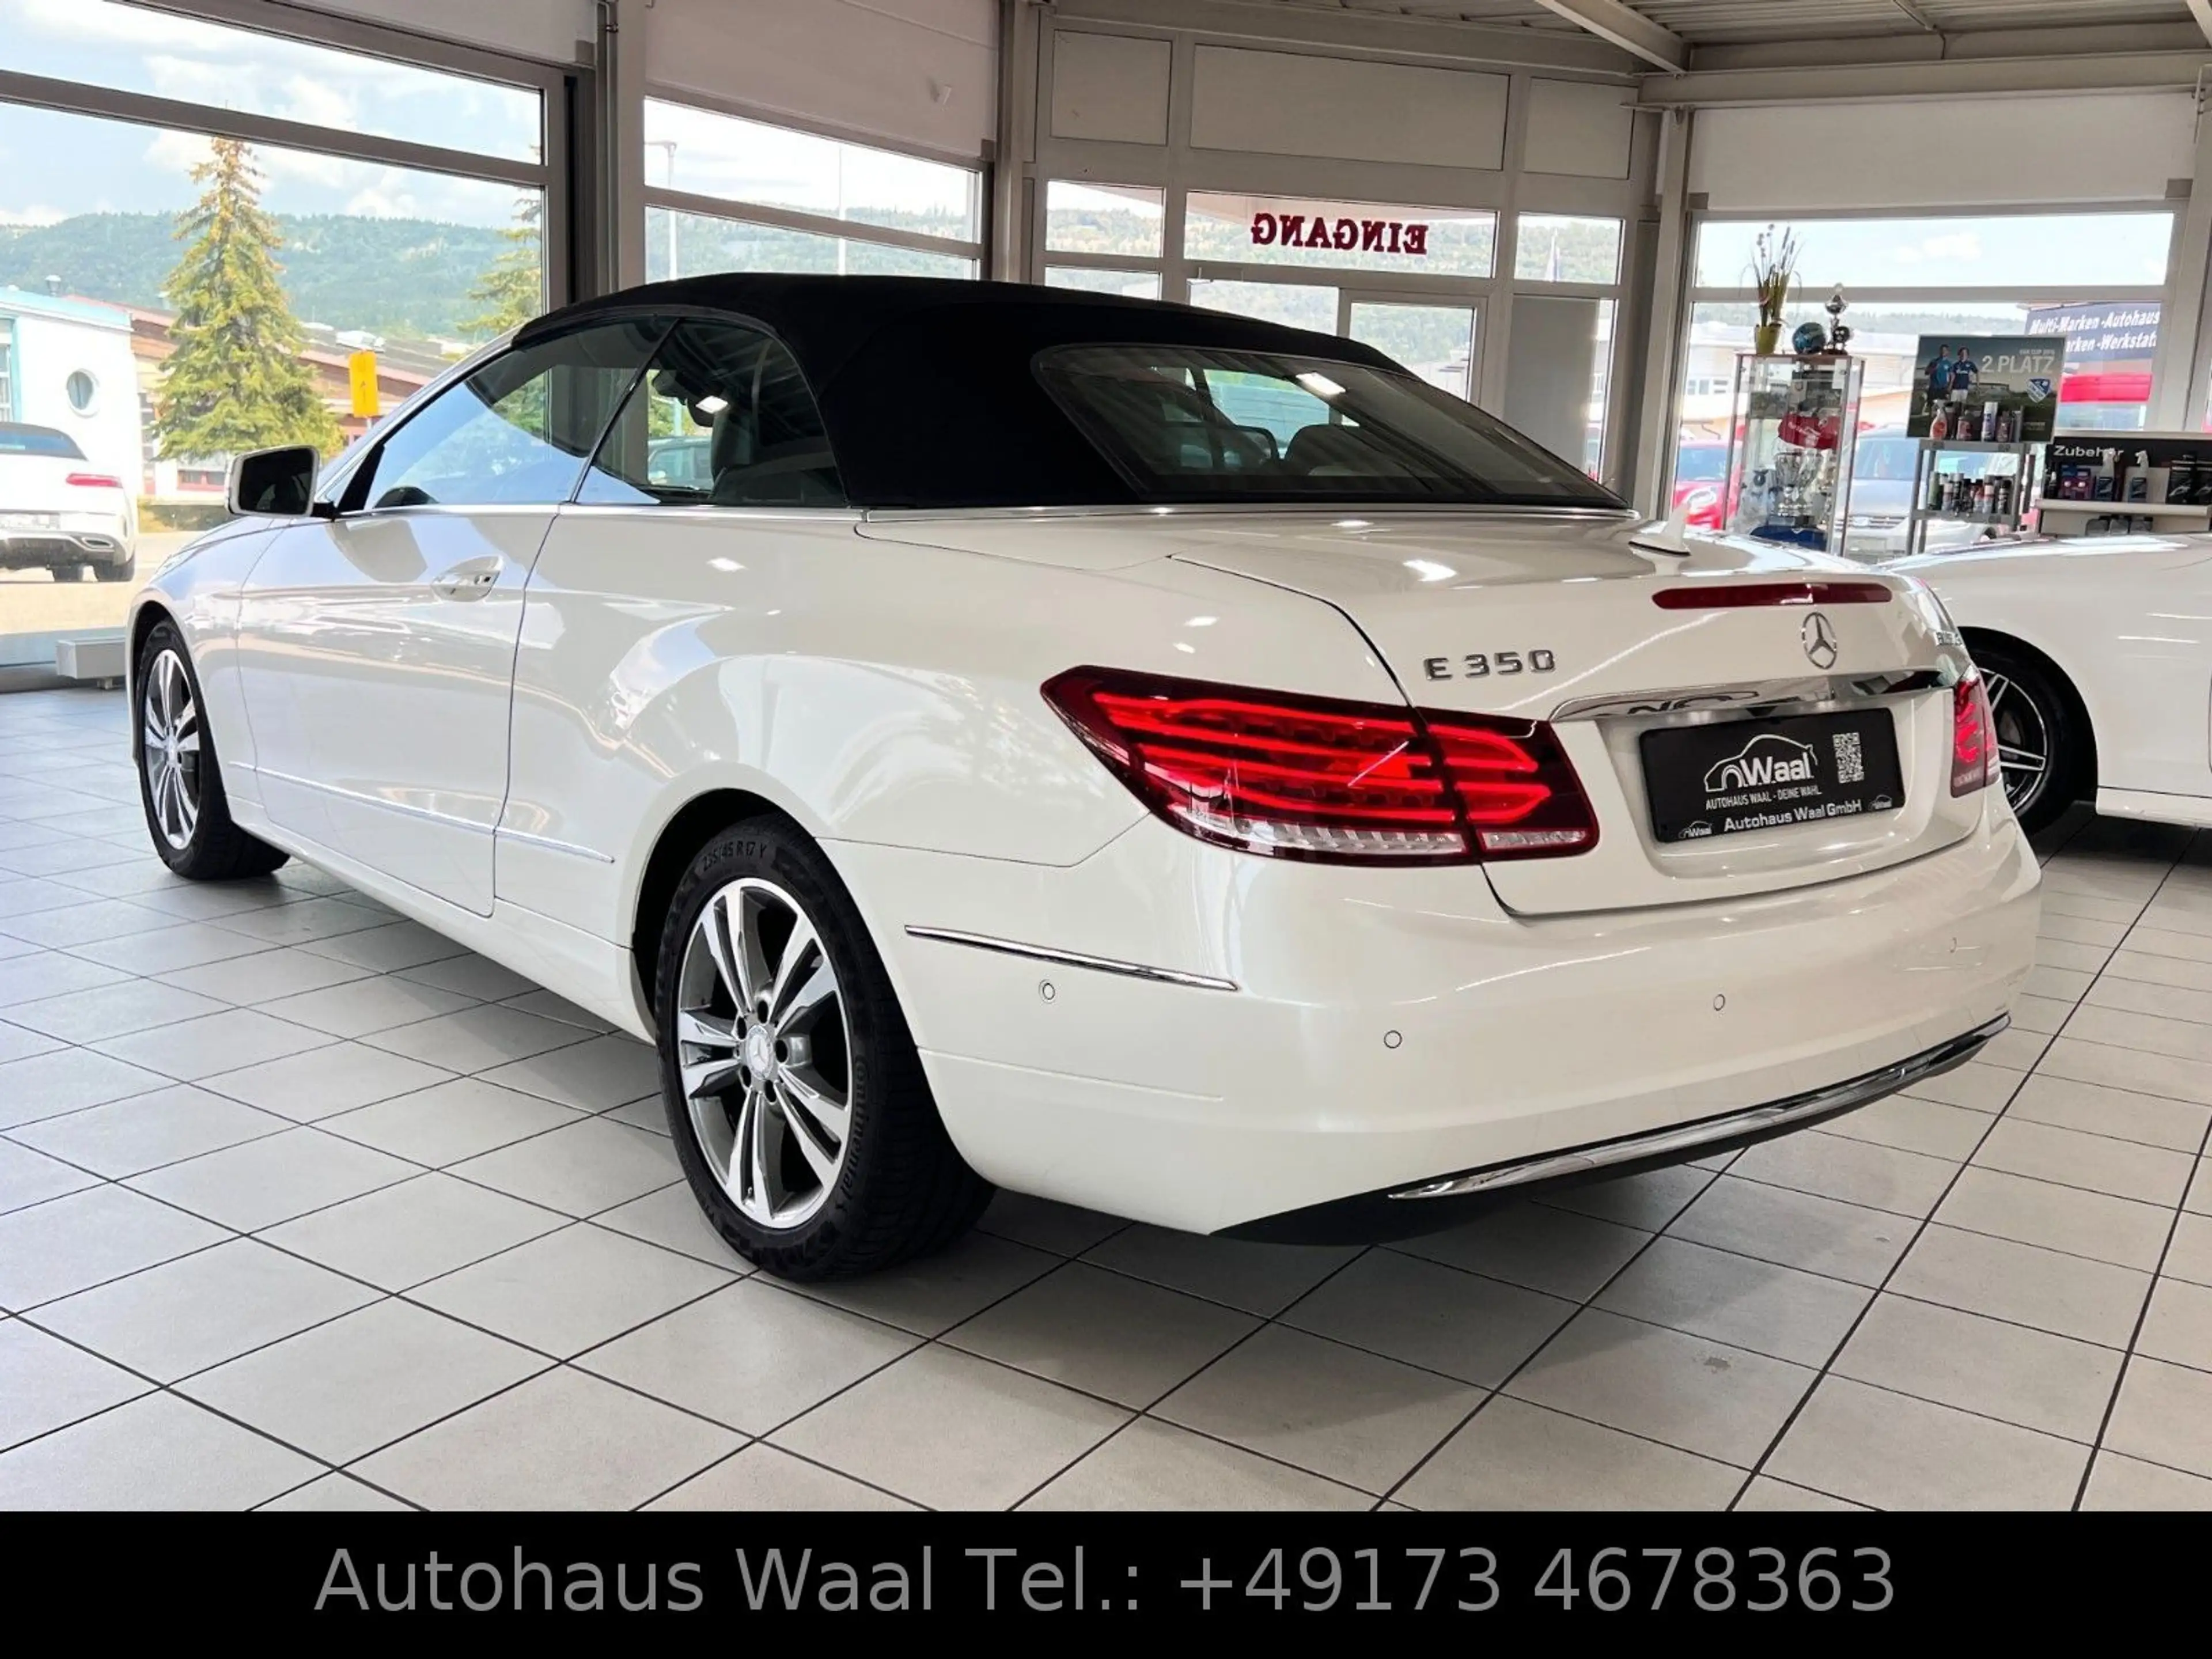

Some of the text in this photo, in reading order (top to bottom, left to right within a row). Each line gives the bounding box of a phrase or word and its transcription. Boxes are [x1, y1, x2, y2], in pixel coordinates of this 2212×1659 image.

[1981, 354, 2055, 374] 2 PLATZ
[2053, 445, 2124, 457] Zubehr
[1423, 649, 1556, 681] E 350
[1706, 794, 1749, 810] AUTOHAUS
[1749, 791, 1772, 804] WAAL
[1778, 787, 1800, 801] DEINE
[1800, 785, 1822, 797] WAHL
[1724, 812, 1793, 832] Autohaus
[1793, 805, 1825, 821] Waal
[1826, 798, 1862, 816] GmbH
